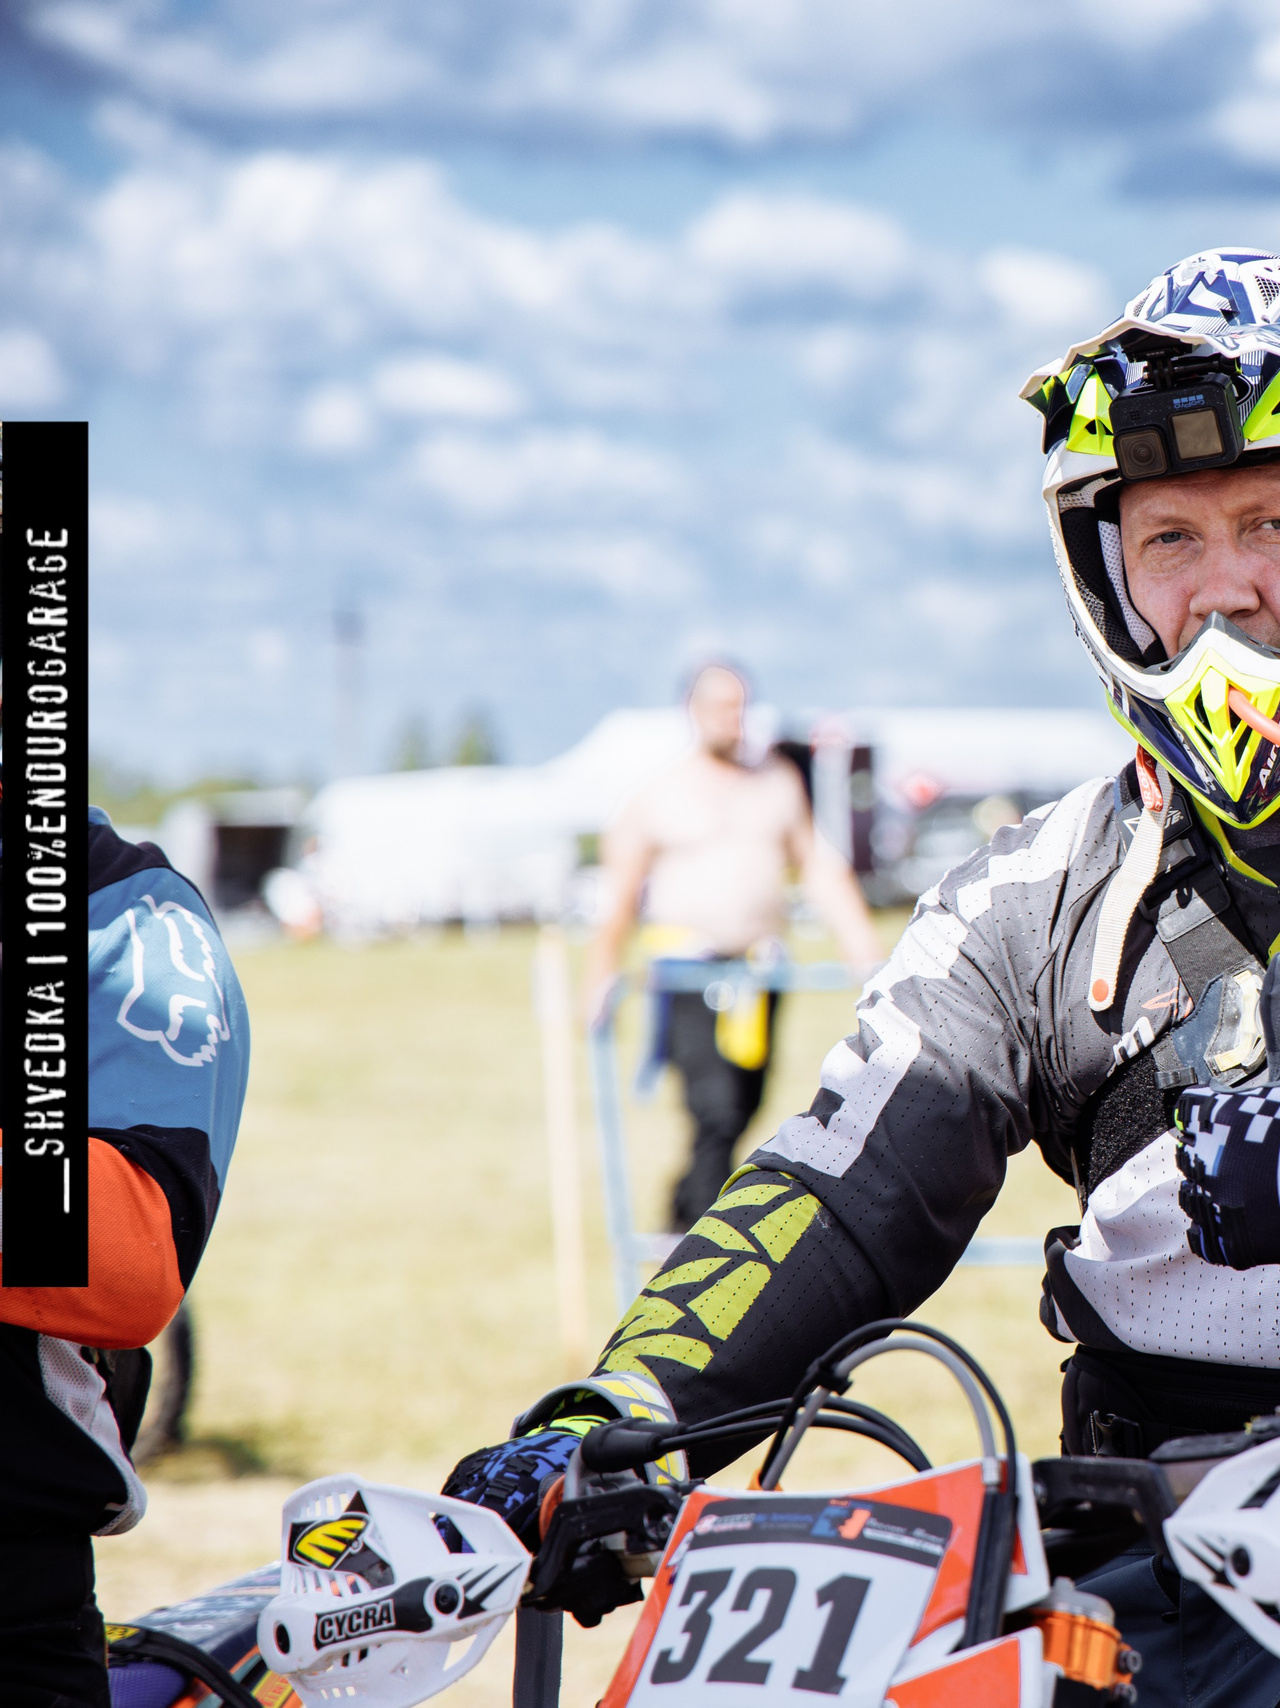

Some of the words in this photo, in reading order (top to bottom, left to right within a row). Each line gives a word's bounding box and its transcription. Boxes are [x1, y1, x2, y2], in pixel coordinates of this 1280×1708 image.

[1173, 399, 1205, 409] GoPro
[318, 1599, 395, 1643] CYCRA
[650, 1566, 872, 1696] 321
